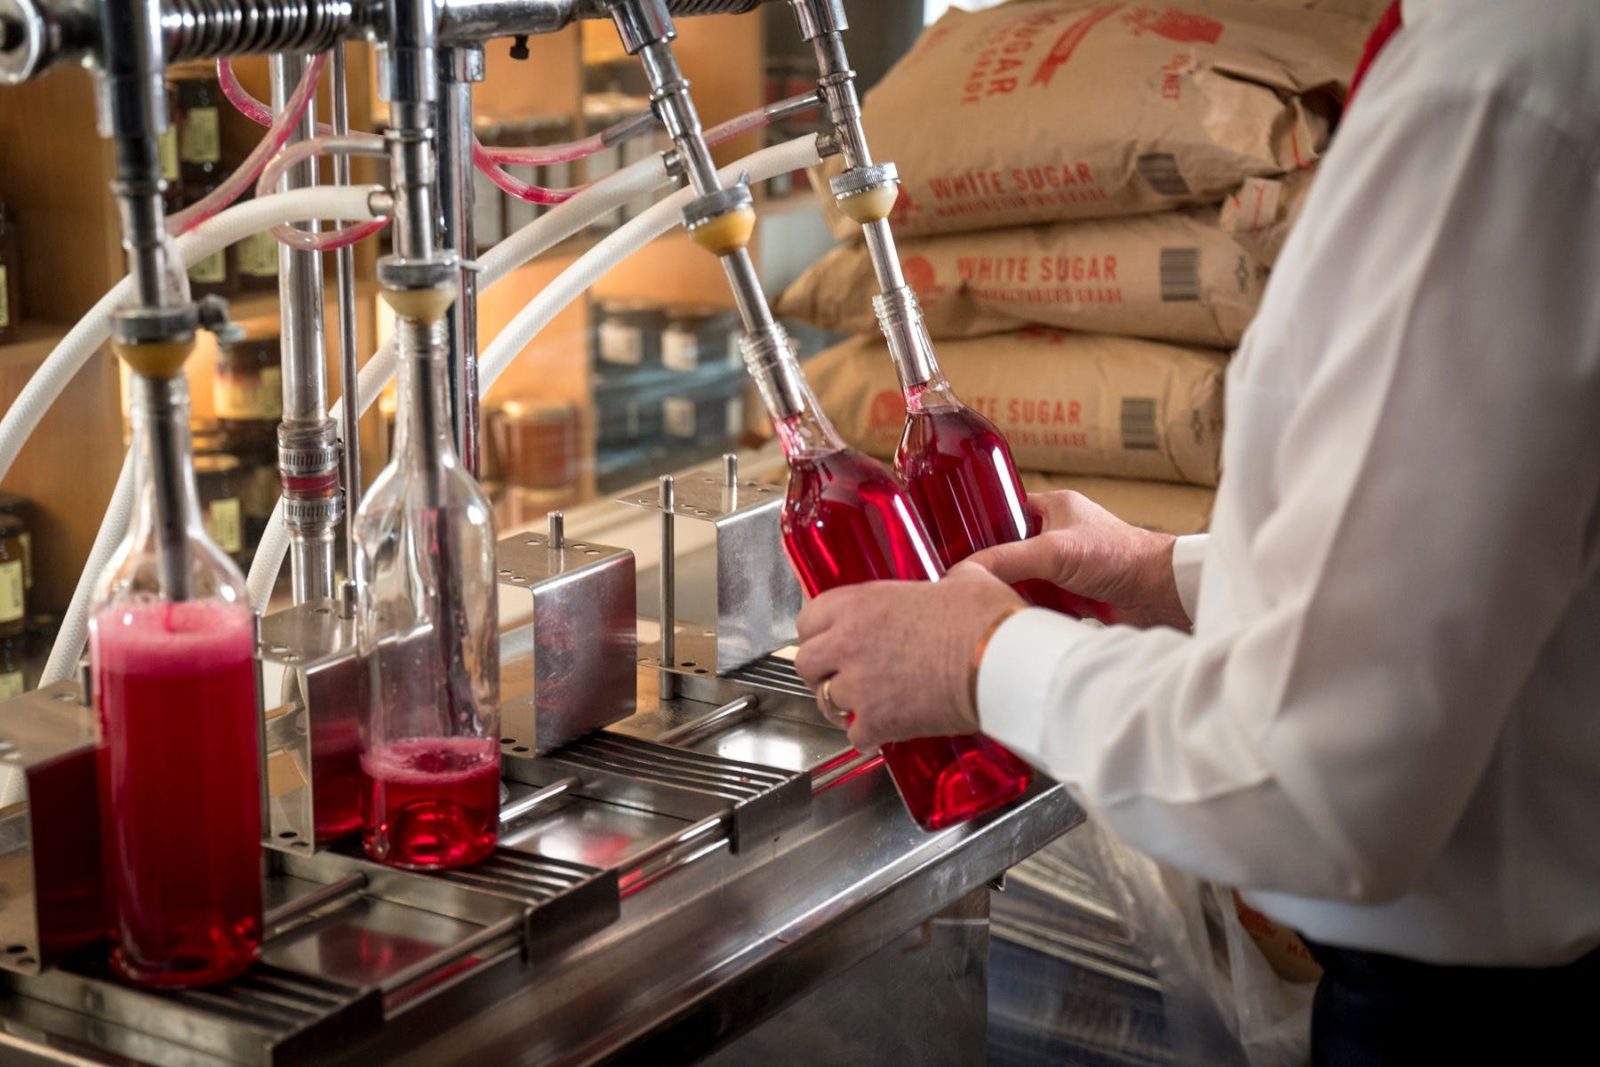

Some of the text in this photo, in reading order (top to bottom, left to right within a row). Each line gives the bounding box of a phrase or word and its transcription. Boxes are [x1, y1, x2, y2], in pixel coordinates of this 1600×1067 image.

[929, 162, 1092, 199] WHITE SUGAR
[957, 255, 1118, 282] WHITE SUGAR
[1007, 398, 1082, 424] SUGAR
